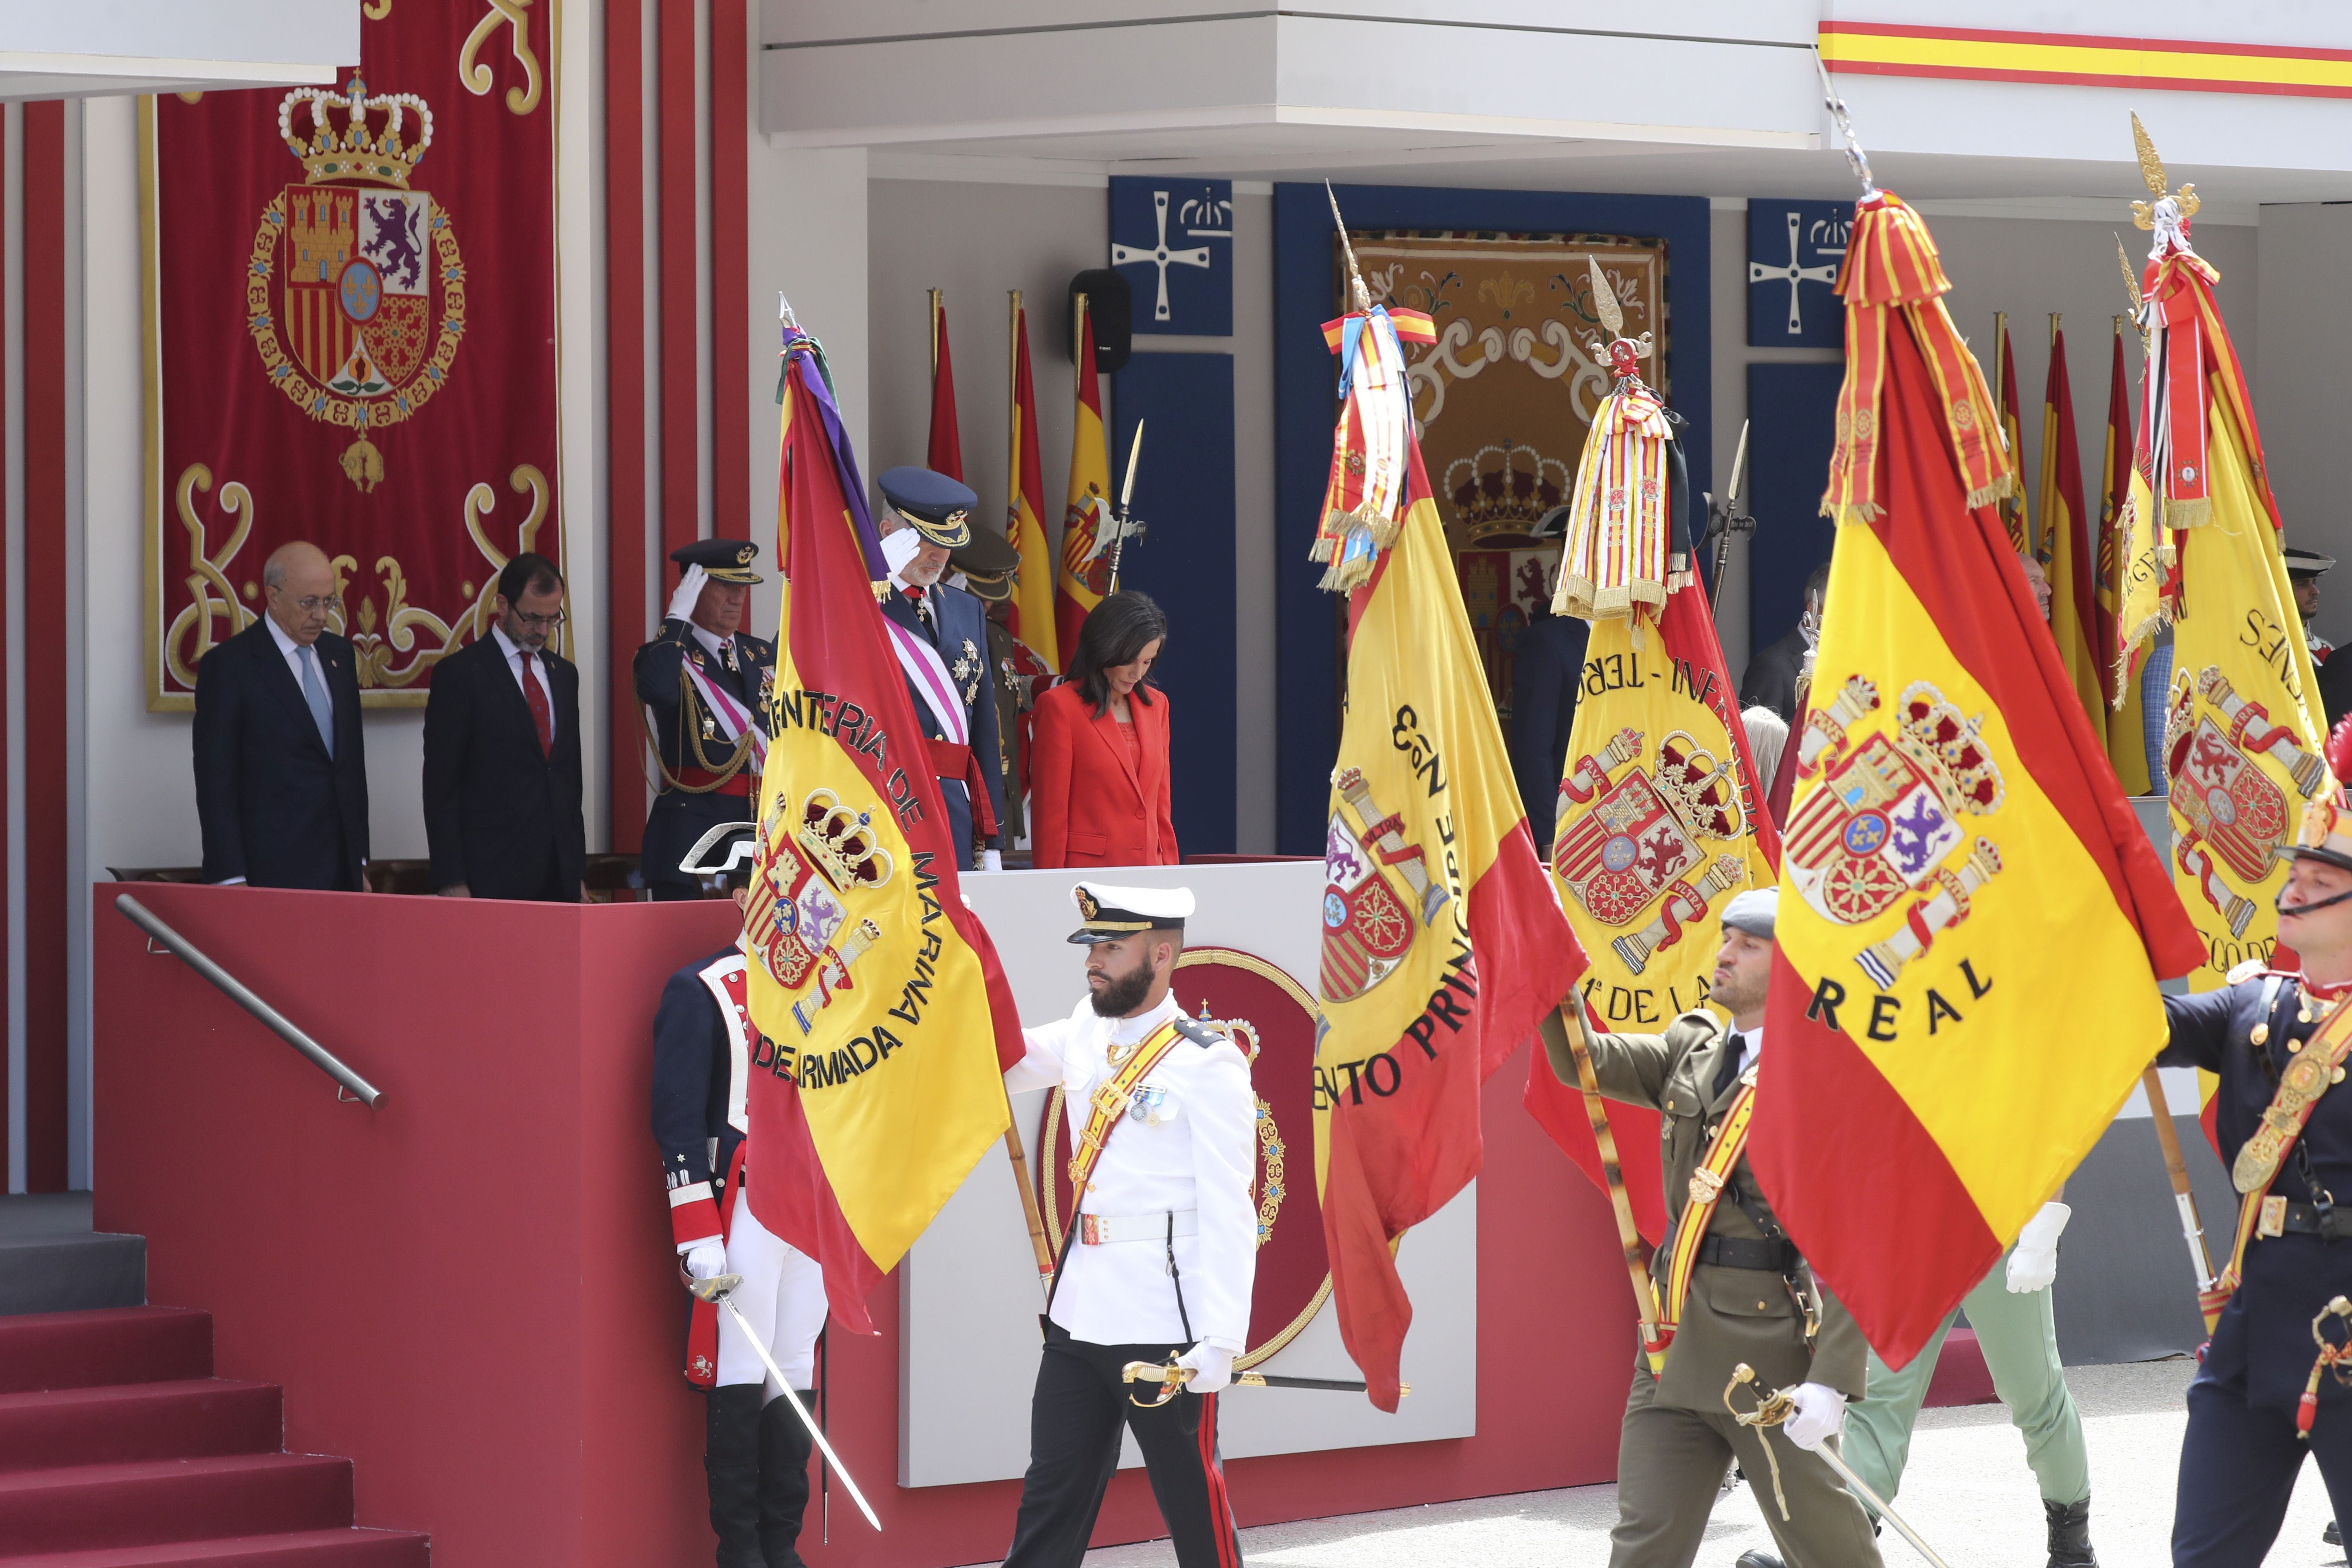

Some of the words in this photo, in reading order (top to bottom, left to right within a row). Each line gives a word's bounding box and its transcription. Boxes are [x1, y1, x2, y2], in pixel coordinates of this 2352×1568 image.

[1584, 760, 1605, 786] PLVS
[886, 767, 924, 833] DE
[1675, 882, 1703, 912] VLTRA
[888, 851, 943, 1026] MARINA
[1608, 986, 1659, 1023] DE
[1801, 957, 1993, 1041] REAL
[752, 1033, 796, 1083] DE
